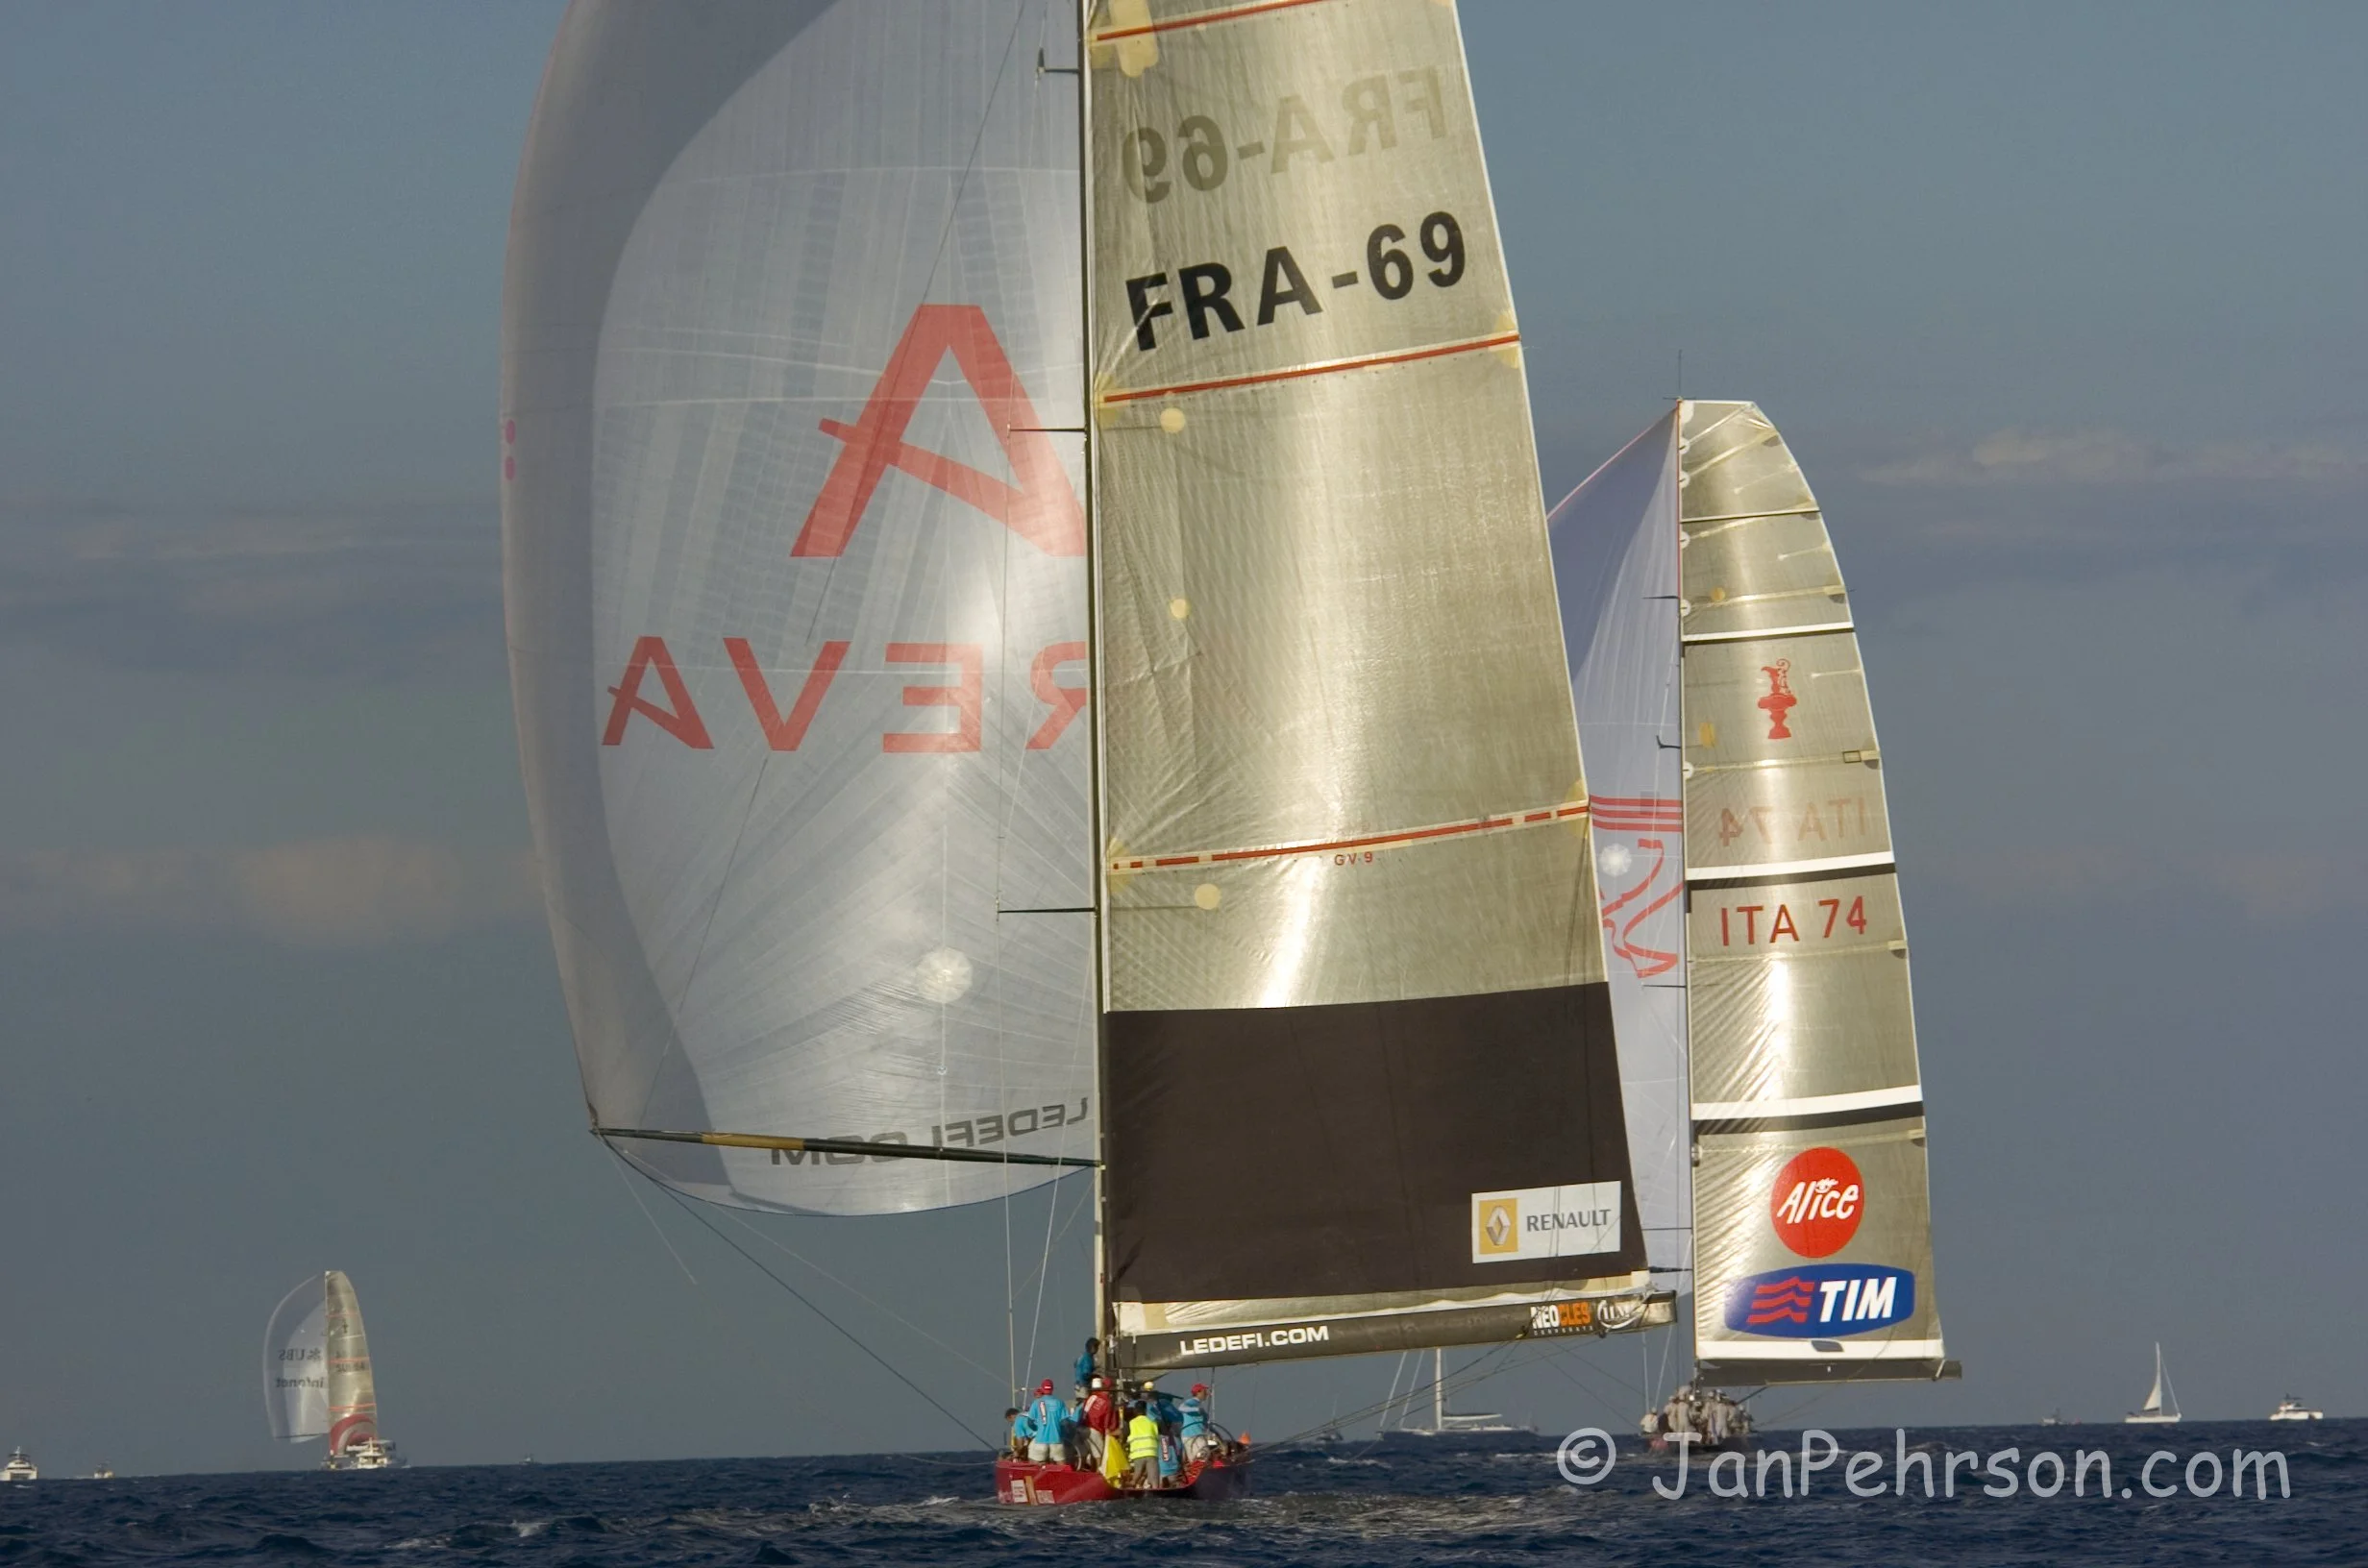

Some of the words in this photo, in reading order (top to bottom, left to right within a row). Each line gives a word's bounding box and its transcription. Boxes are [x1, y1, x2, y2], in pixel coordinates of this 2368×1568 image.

[1125, 211, 1466, 352] FRA-69
[1720, 903, 1800, 947] ITA
[1818, 894, 1868, 940] 74
[1526, 1209, 1612, 1233] RENAULT
[1777, 1178, 1860, 1225] Alice
[1819, 1276, 1898, 1323] TIM
[1179, 1325, 1330, 1356] LEDEFI.COM
